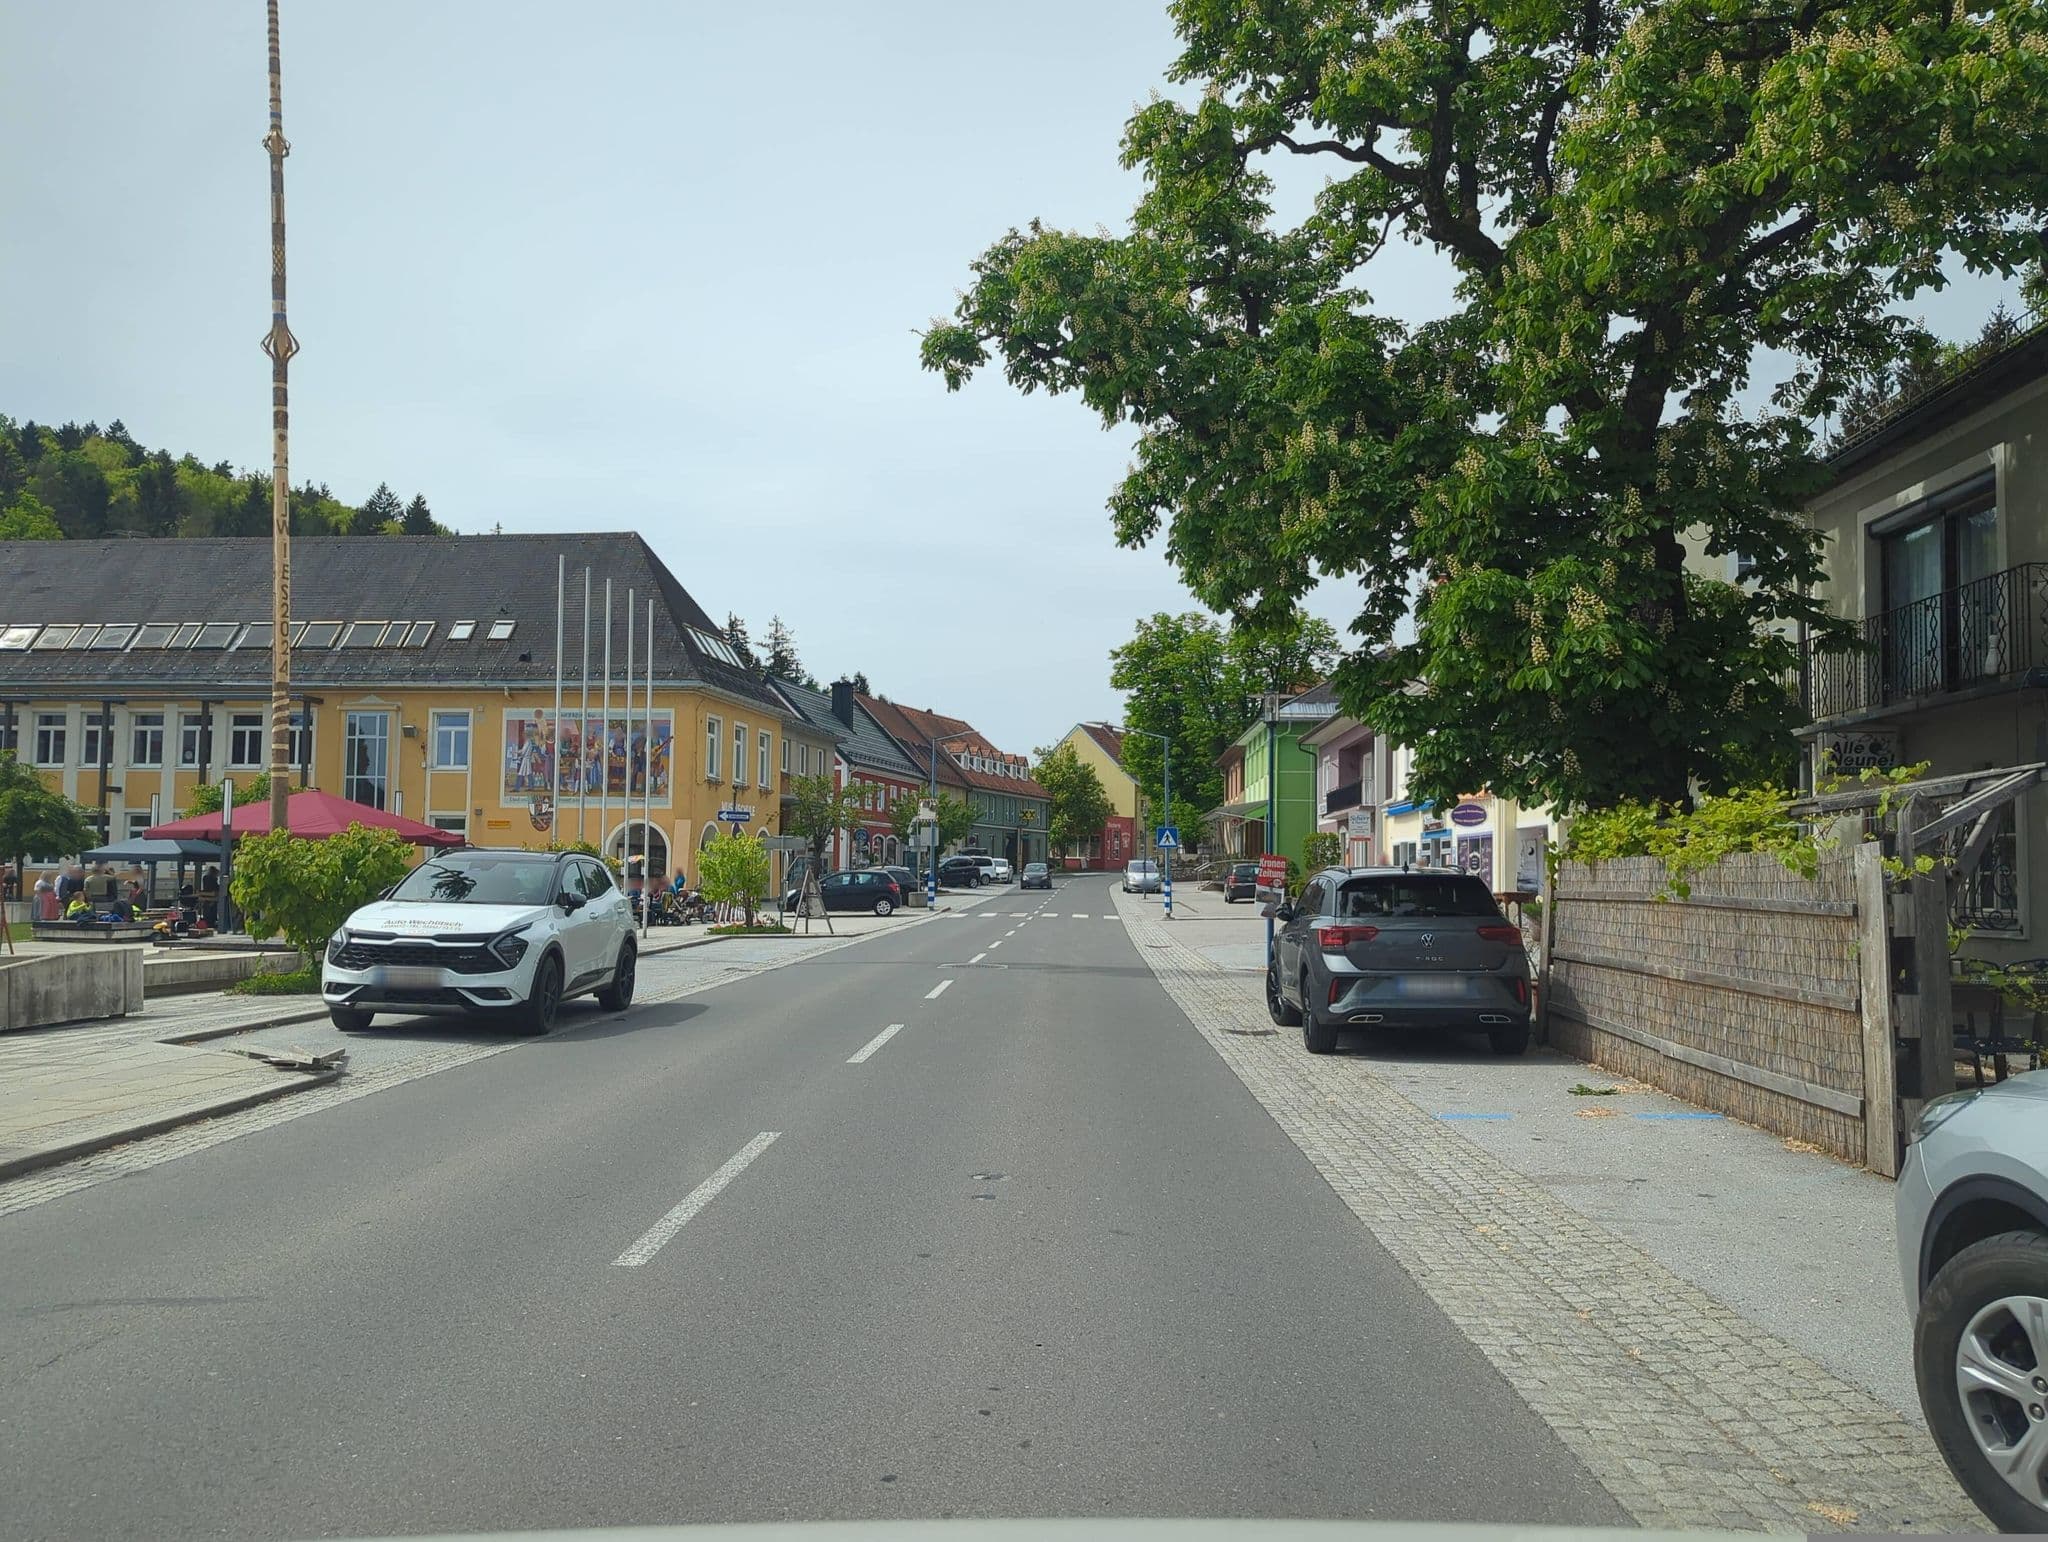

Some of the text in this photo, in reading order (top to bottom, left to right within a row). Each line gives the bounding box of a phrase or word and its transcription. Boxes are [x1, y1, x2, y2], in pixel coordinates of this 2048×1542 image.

[1831, 741, 1864, 754] Alle
[1831, 754, 1895, 767] Neune!
[1259, 869, 1286, 880] Zeitung
